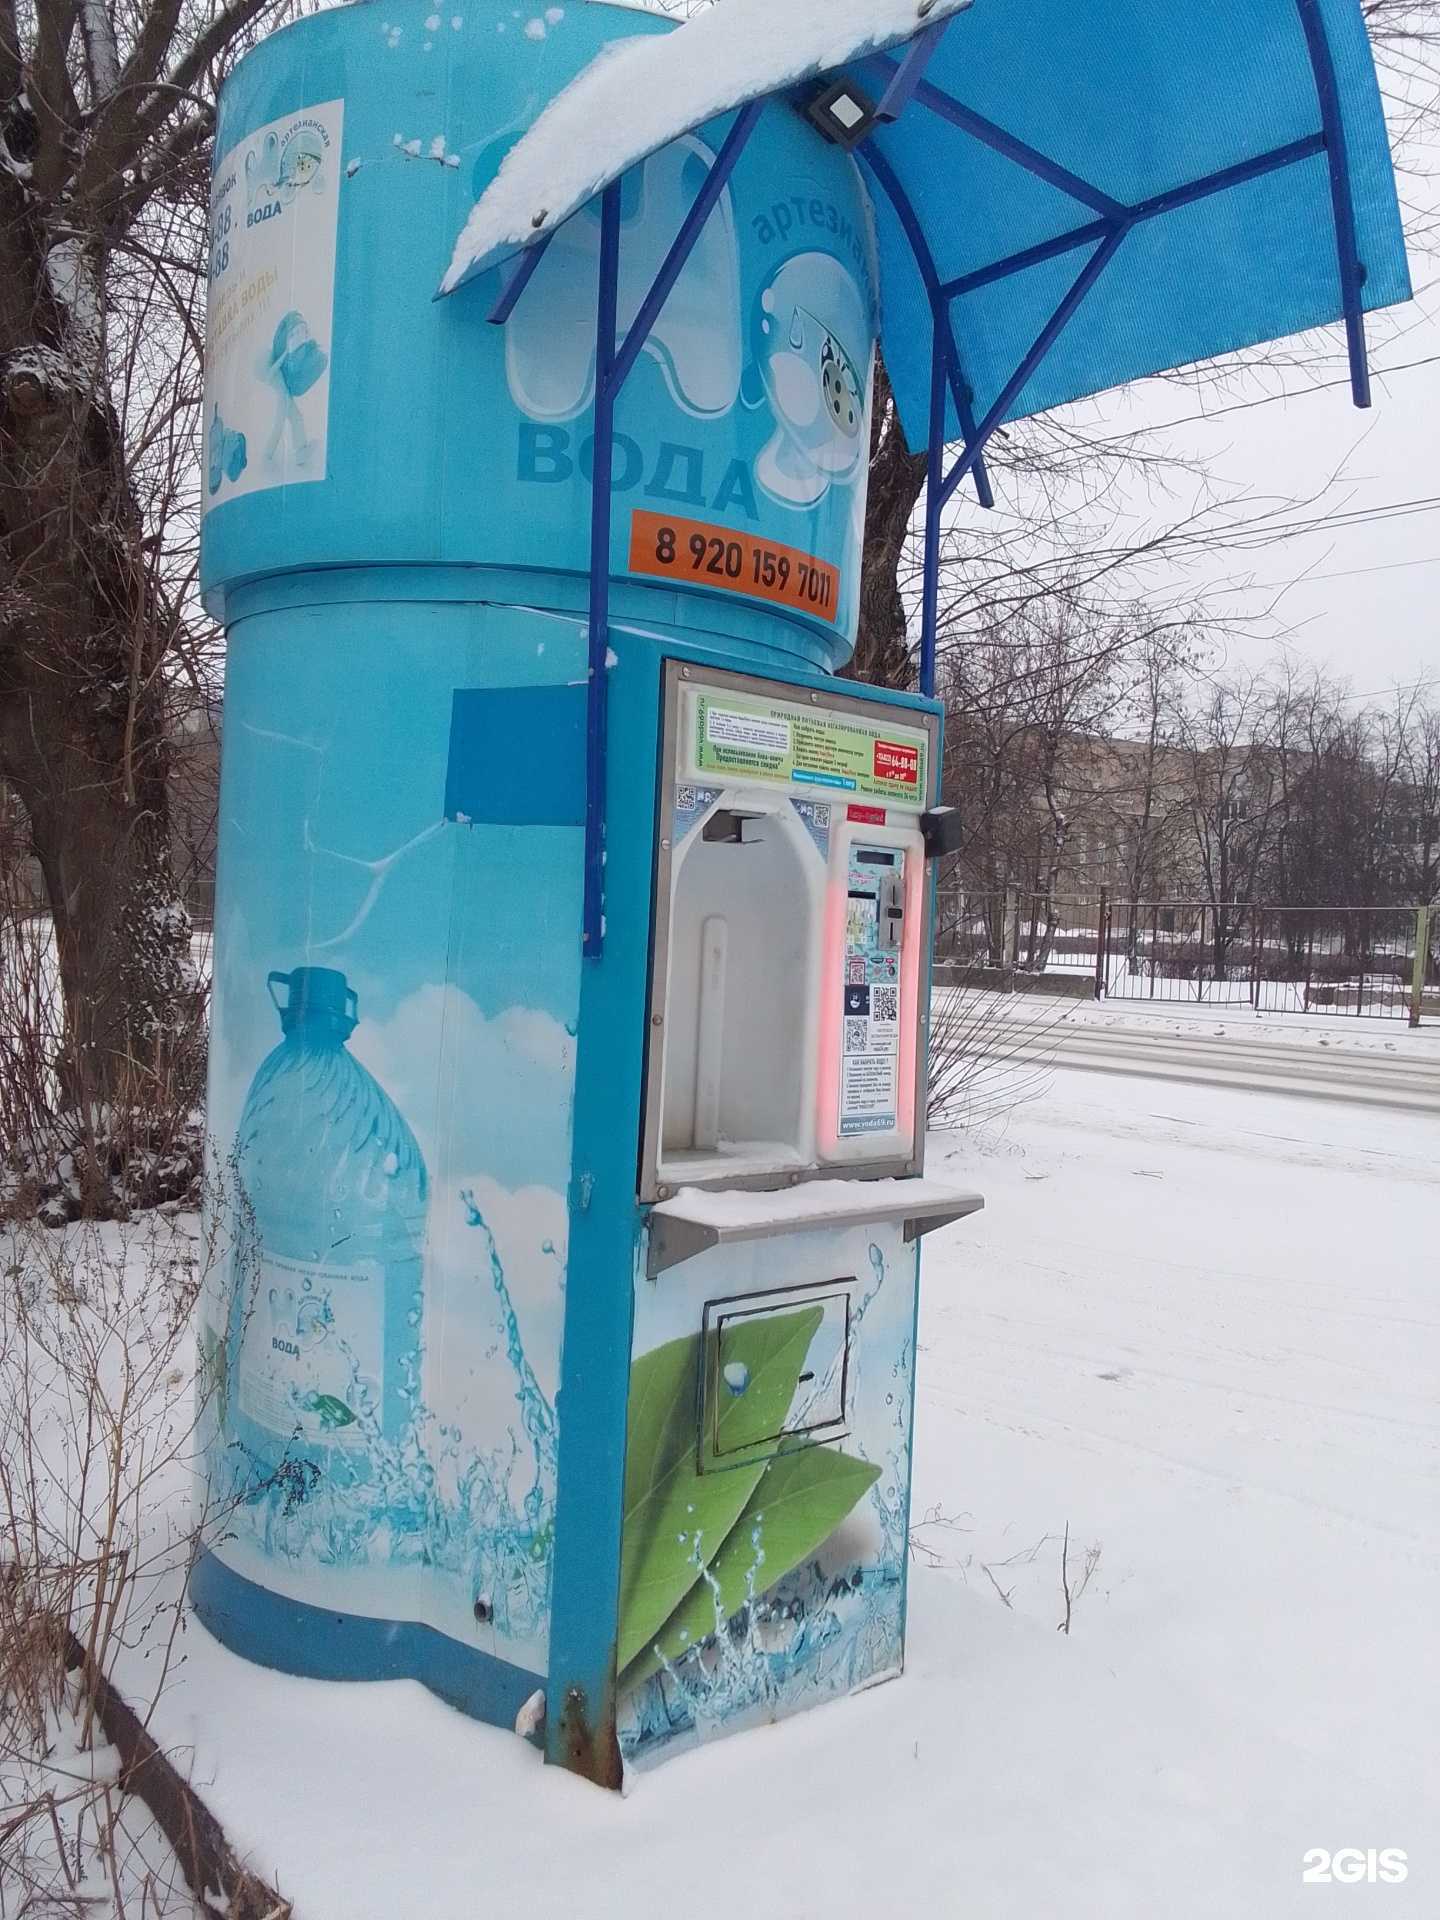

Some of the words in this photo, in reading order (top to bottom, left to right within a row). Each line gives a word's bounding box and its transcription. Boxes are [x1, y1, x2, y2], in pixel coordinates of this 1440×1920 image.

[246, 199, 283, 229] ВОДА
[516, 422, 760, 521] ВОДА
[656, 527, 676, 564] 8
[689, 533, 743, 578] 920
[753, 548, 791, 592] 159
[797, 562, 831, 608] 7011
[272, 1336, 301, 1359] ВОДА
